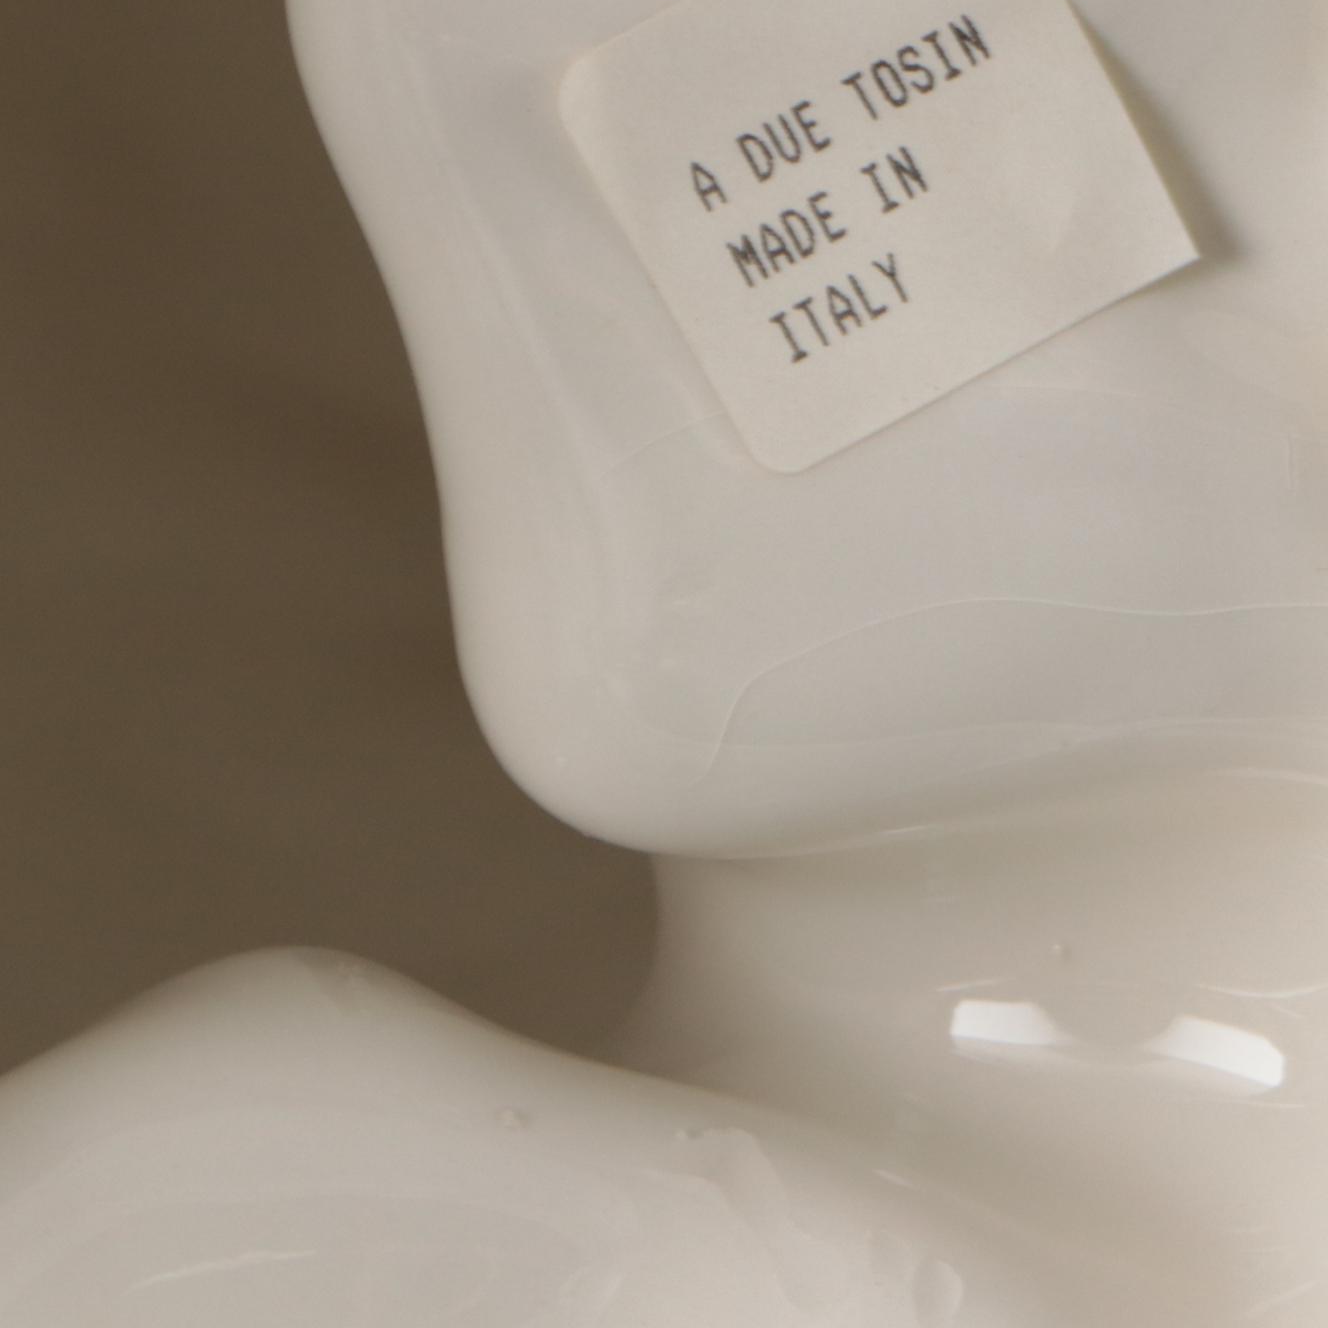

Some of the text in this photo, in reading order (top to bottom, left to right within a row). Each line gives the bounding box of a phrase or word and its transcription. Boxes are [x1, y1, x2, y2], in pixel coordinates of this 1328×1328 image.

[690, 13, 991, 212] A DUE TOSIN
[725, 145, 929, 288] MADE IN
[768, 252, 909, 364] ITALY
